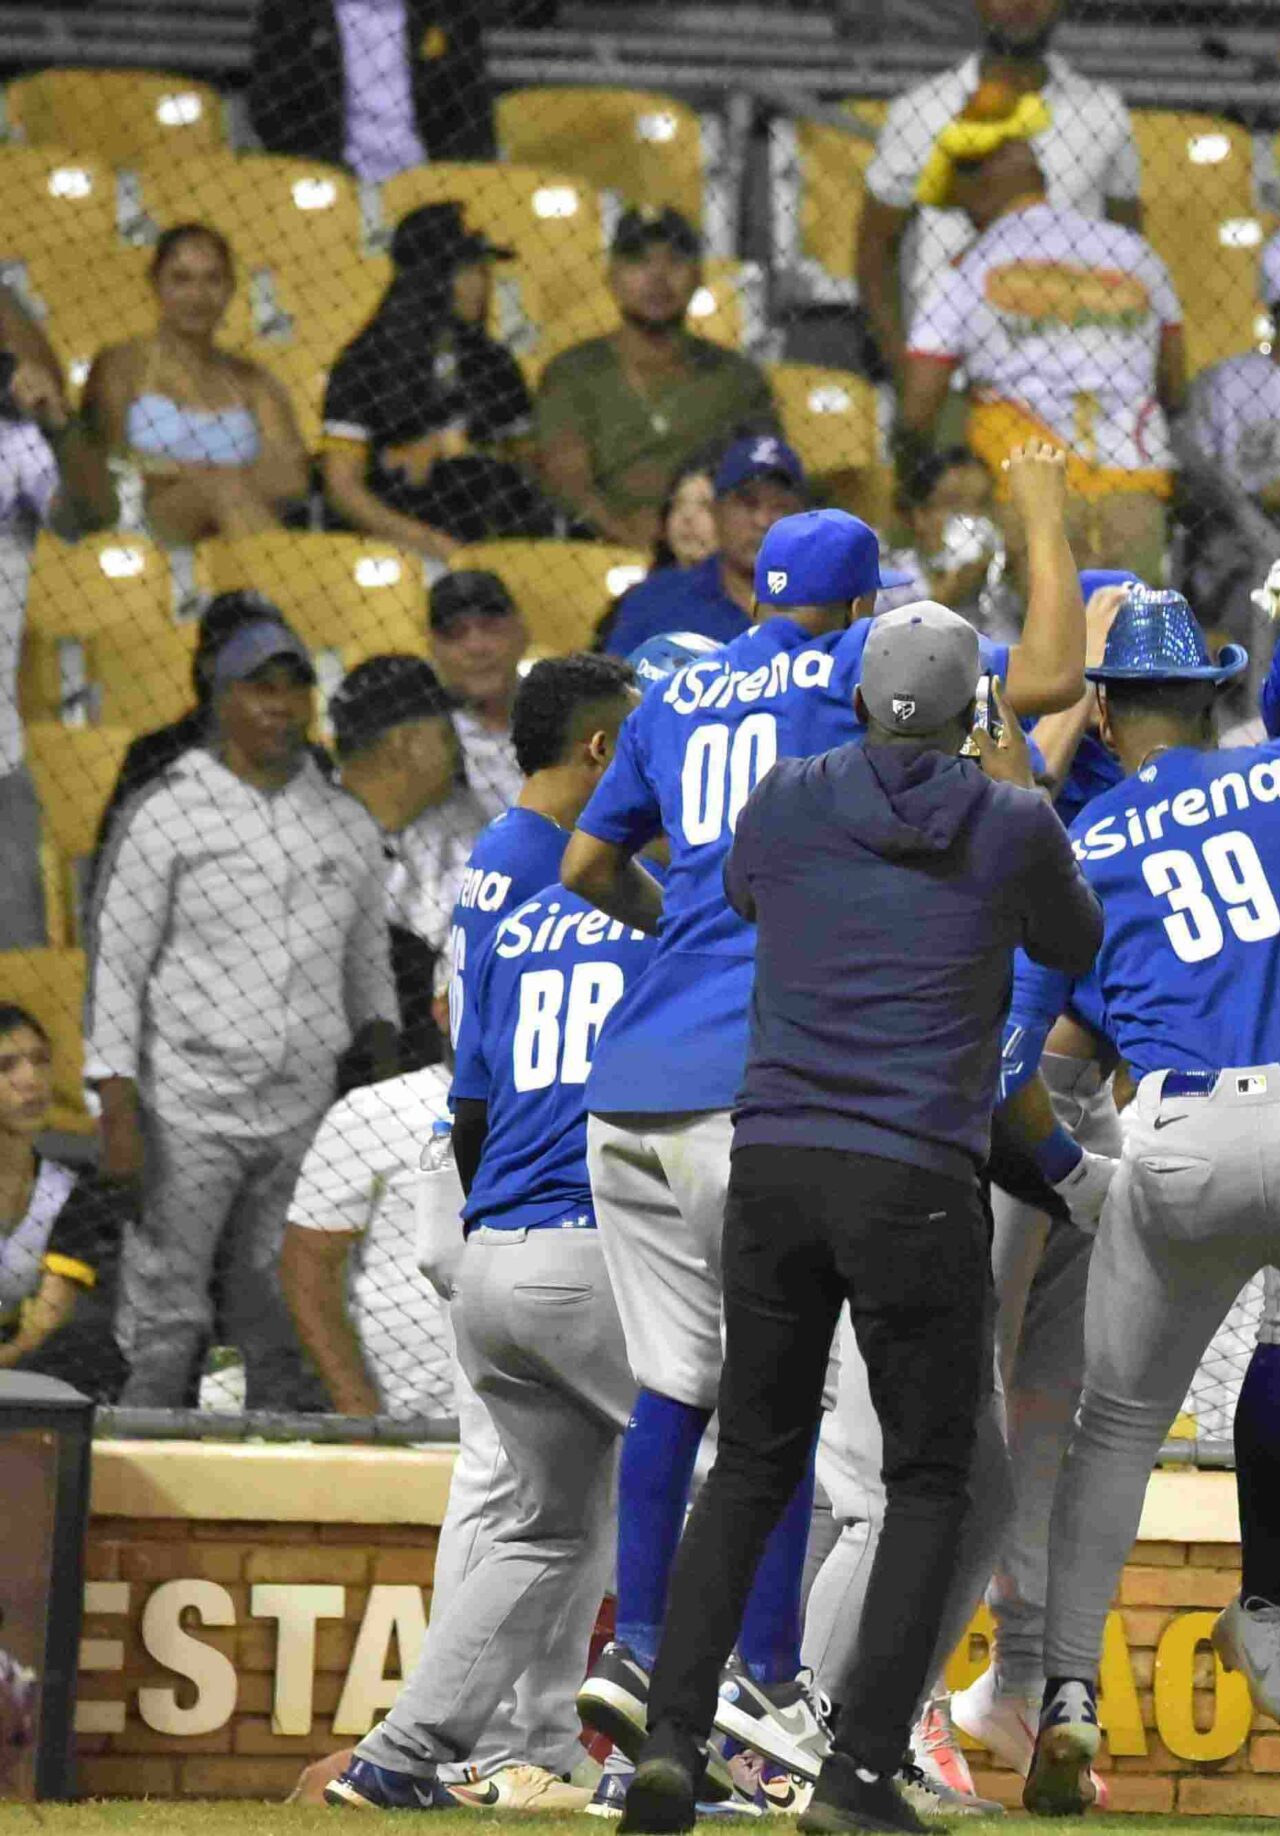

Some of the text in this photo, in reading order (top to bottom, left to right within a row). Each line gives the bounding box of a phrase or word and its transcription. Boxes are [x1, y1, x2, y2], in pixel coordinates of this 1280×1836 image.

[663, 651, 835, 714] Sirena
[494, 902, 646, 959] Siren
[74, 1578, 437, 1736] ESTA
